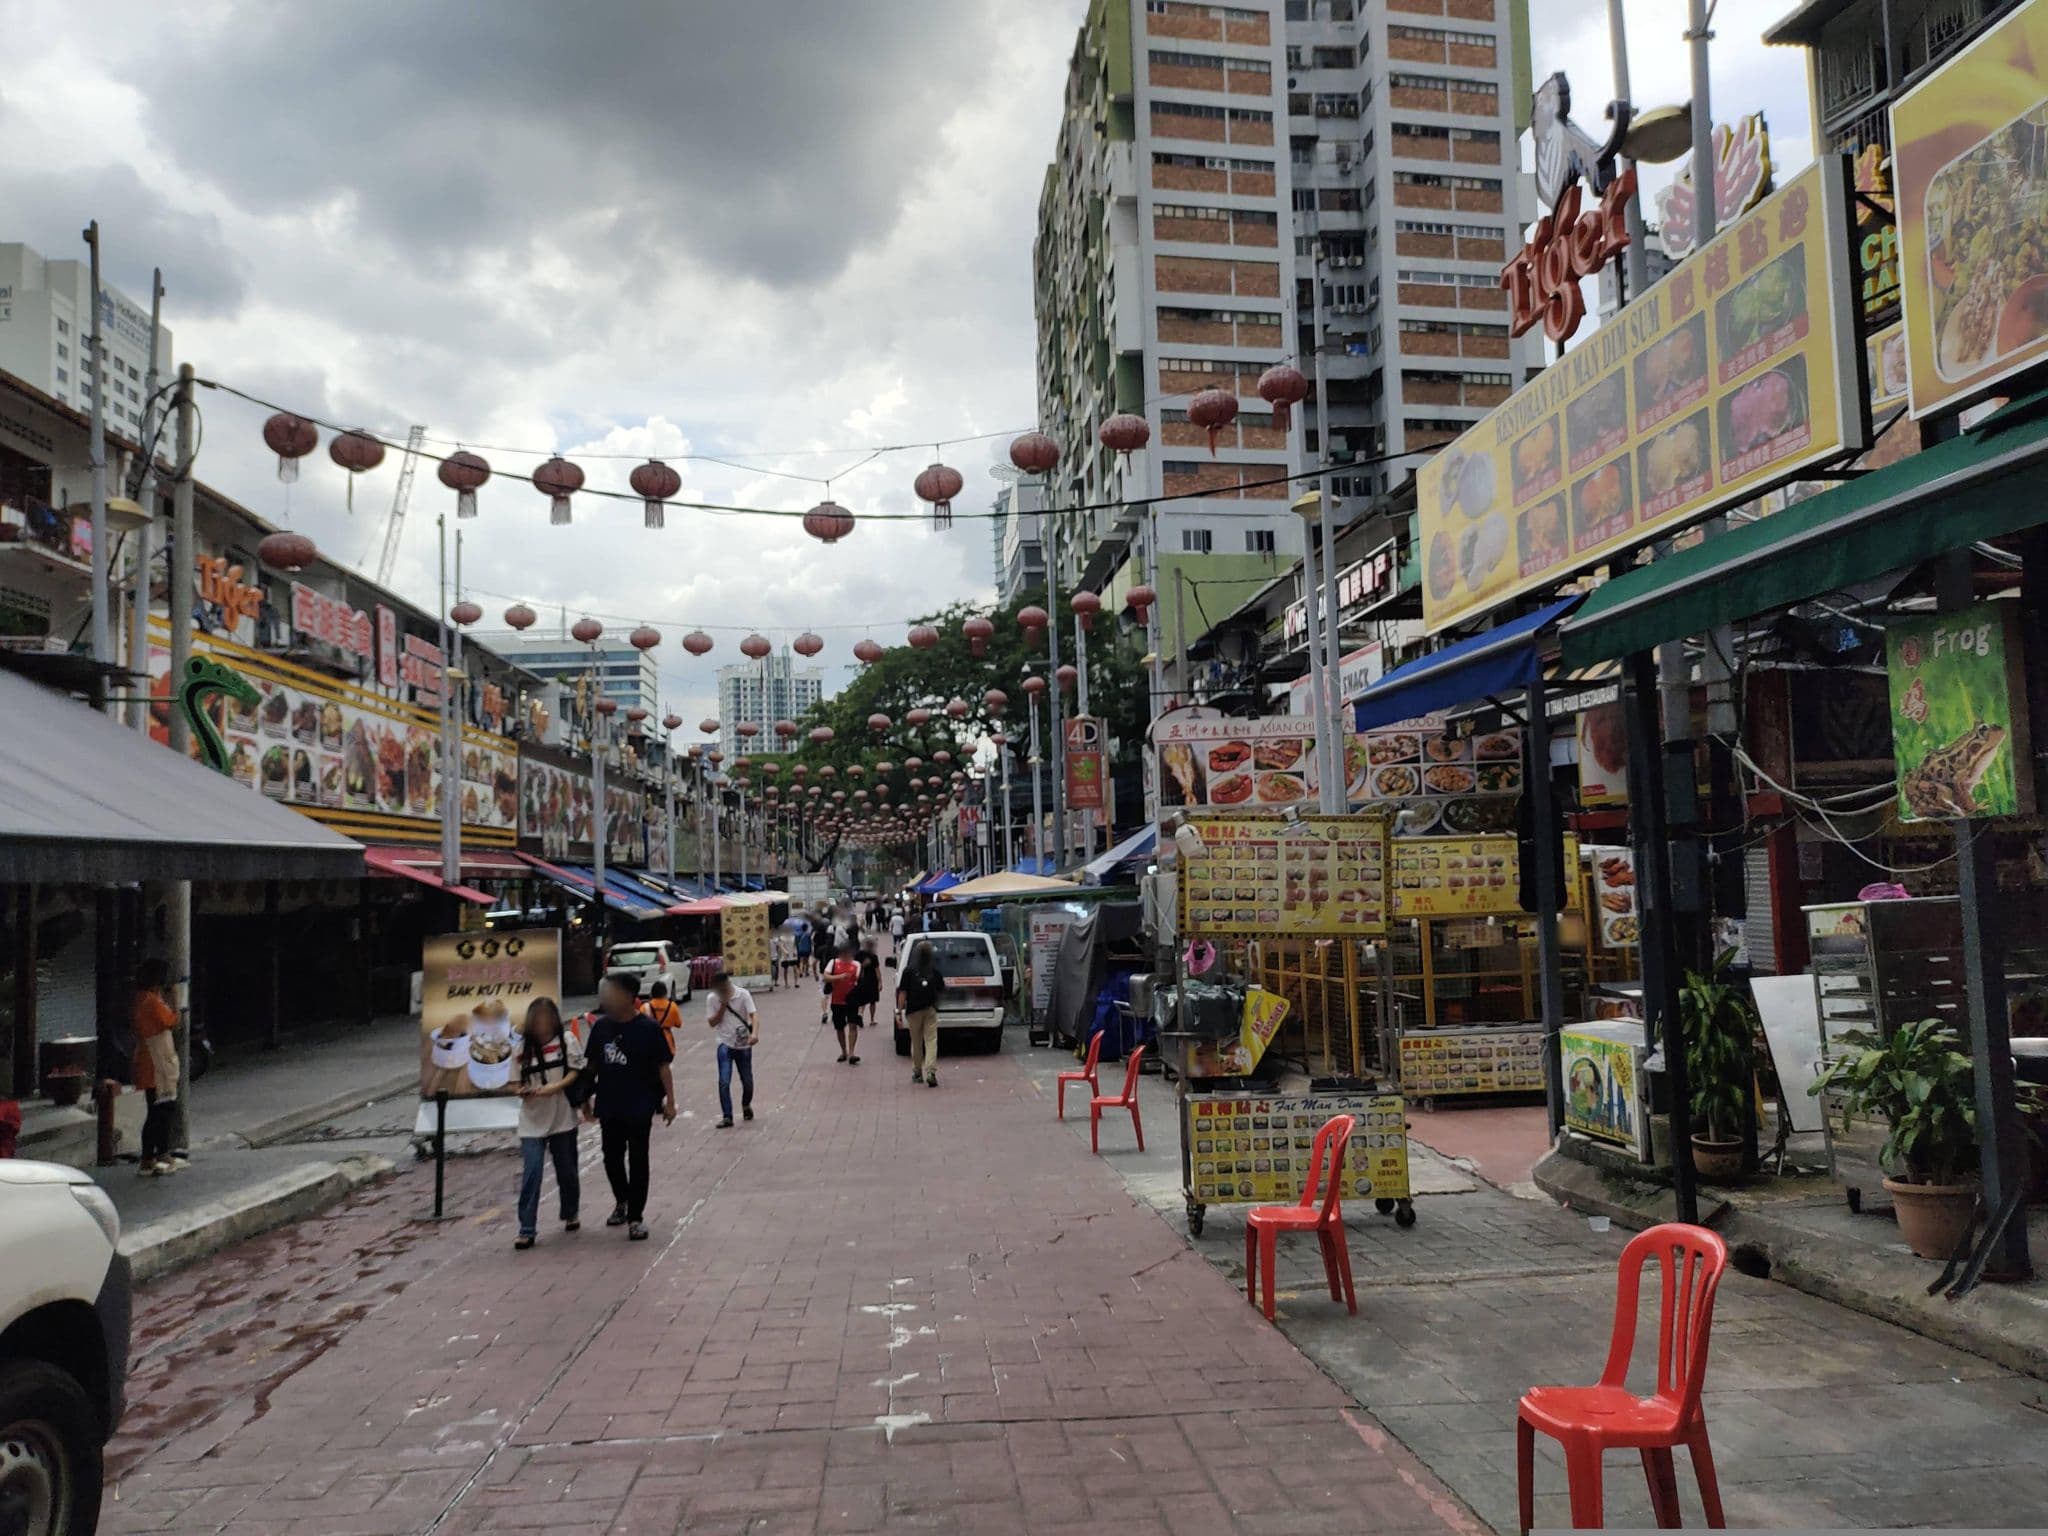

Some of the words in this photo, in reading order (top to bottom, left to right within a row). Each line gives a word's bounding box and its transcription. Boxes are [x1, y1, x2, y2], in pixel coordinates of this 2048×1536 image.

[1501, 168, 1636, 344] Tiger
[1550, 362, 1570, 406] FAT
[1573, 341, 1601, 390] MAN
[1602, 319, 1628, 369] DIM
[1630, 295, 1660, 348] SUM
[196, 553, 264, 632] Tiger
[1932, 623, 1991, 657] Frog
[1261, 721, 1292, 733] ASIAN
[448, 985, 475, 999] BAK
[477, 981, 503, 997] KUT
[507, 981, 532, 994] TEH
[1274, 1098, 1296, 1112] Fat
[1301, 1098, 1332, 1111] Man
[1337, 1096, 1363, 1109] Dim
[1368, 1095, 1396, 1108] Sum
